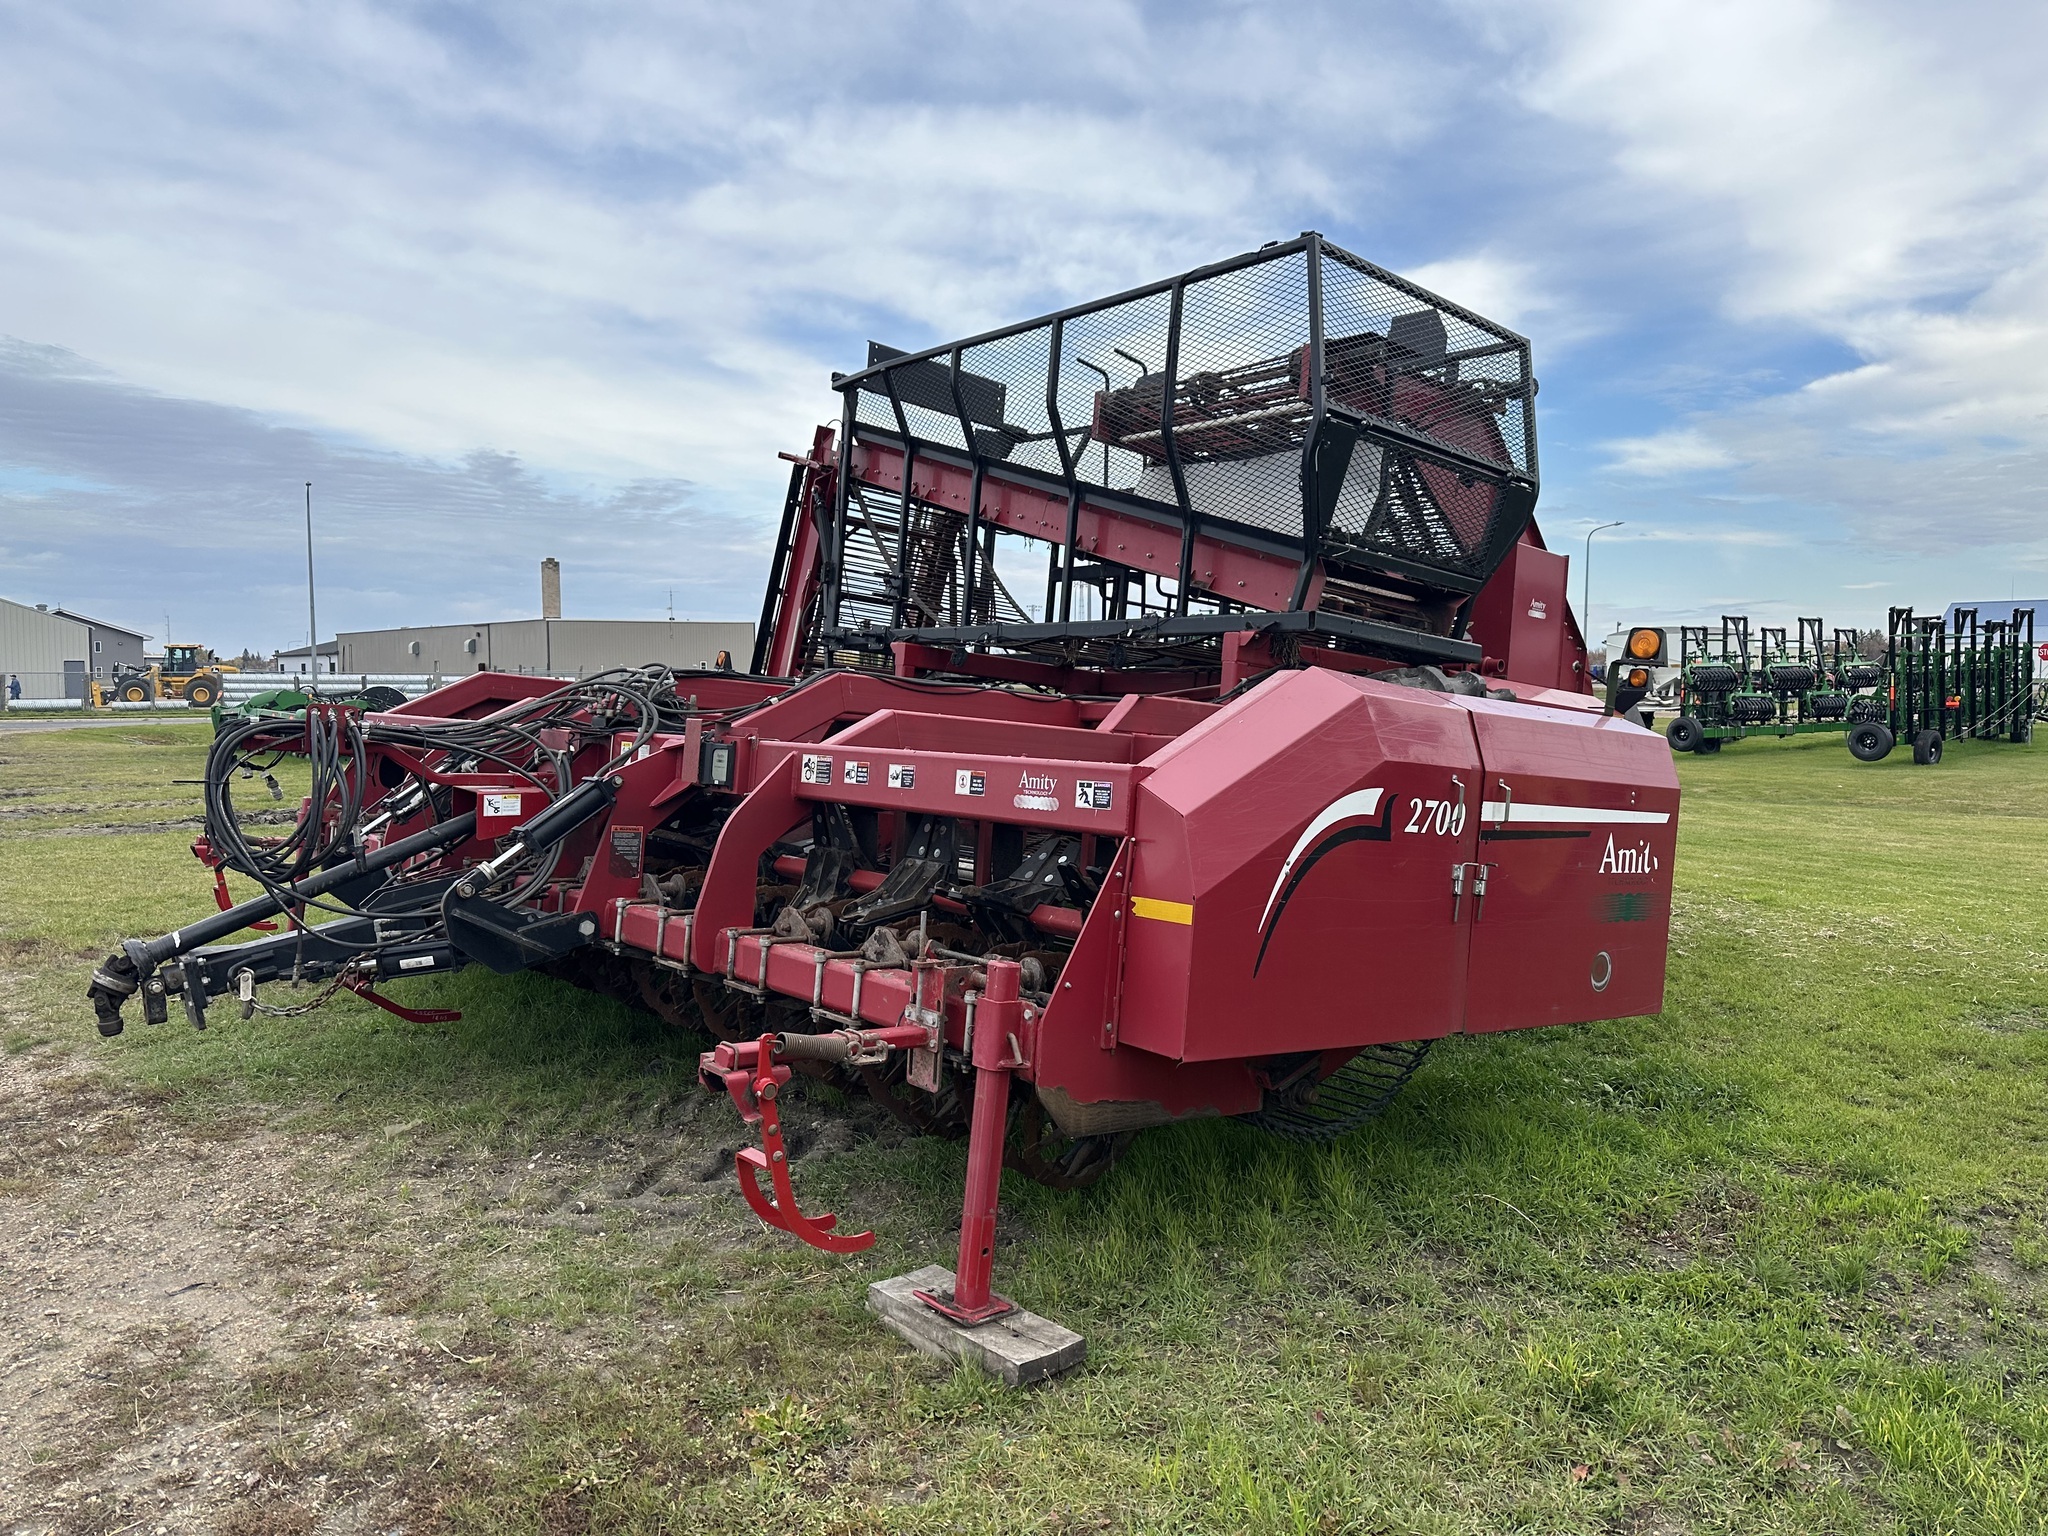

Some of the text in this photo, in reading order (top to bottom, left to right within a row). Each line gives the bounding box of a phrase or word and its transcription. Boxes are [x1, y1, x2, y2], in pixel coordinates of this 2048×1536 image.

[1530, 597, 1546, 611] Amity
[2039, 648, 2048, 656] ST
[1018, 769, 1058, 795] Amity
[1404, 798, 1466, 837] 2700
[1598, 832, 1659, 884] Amit
